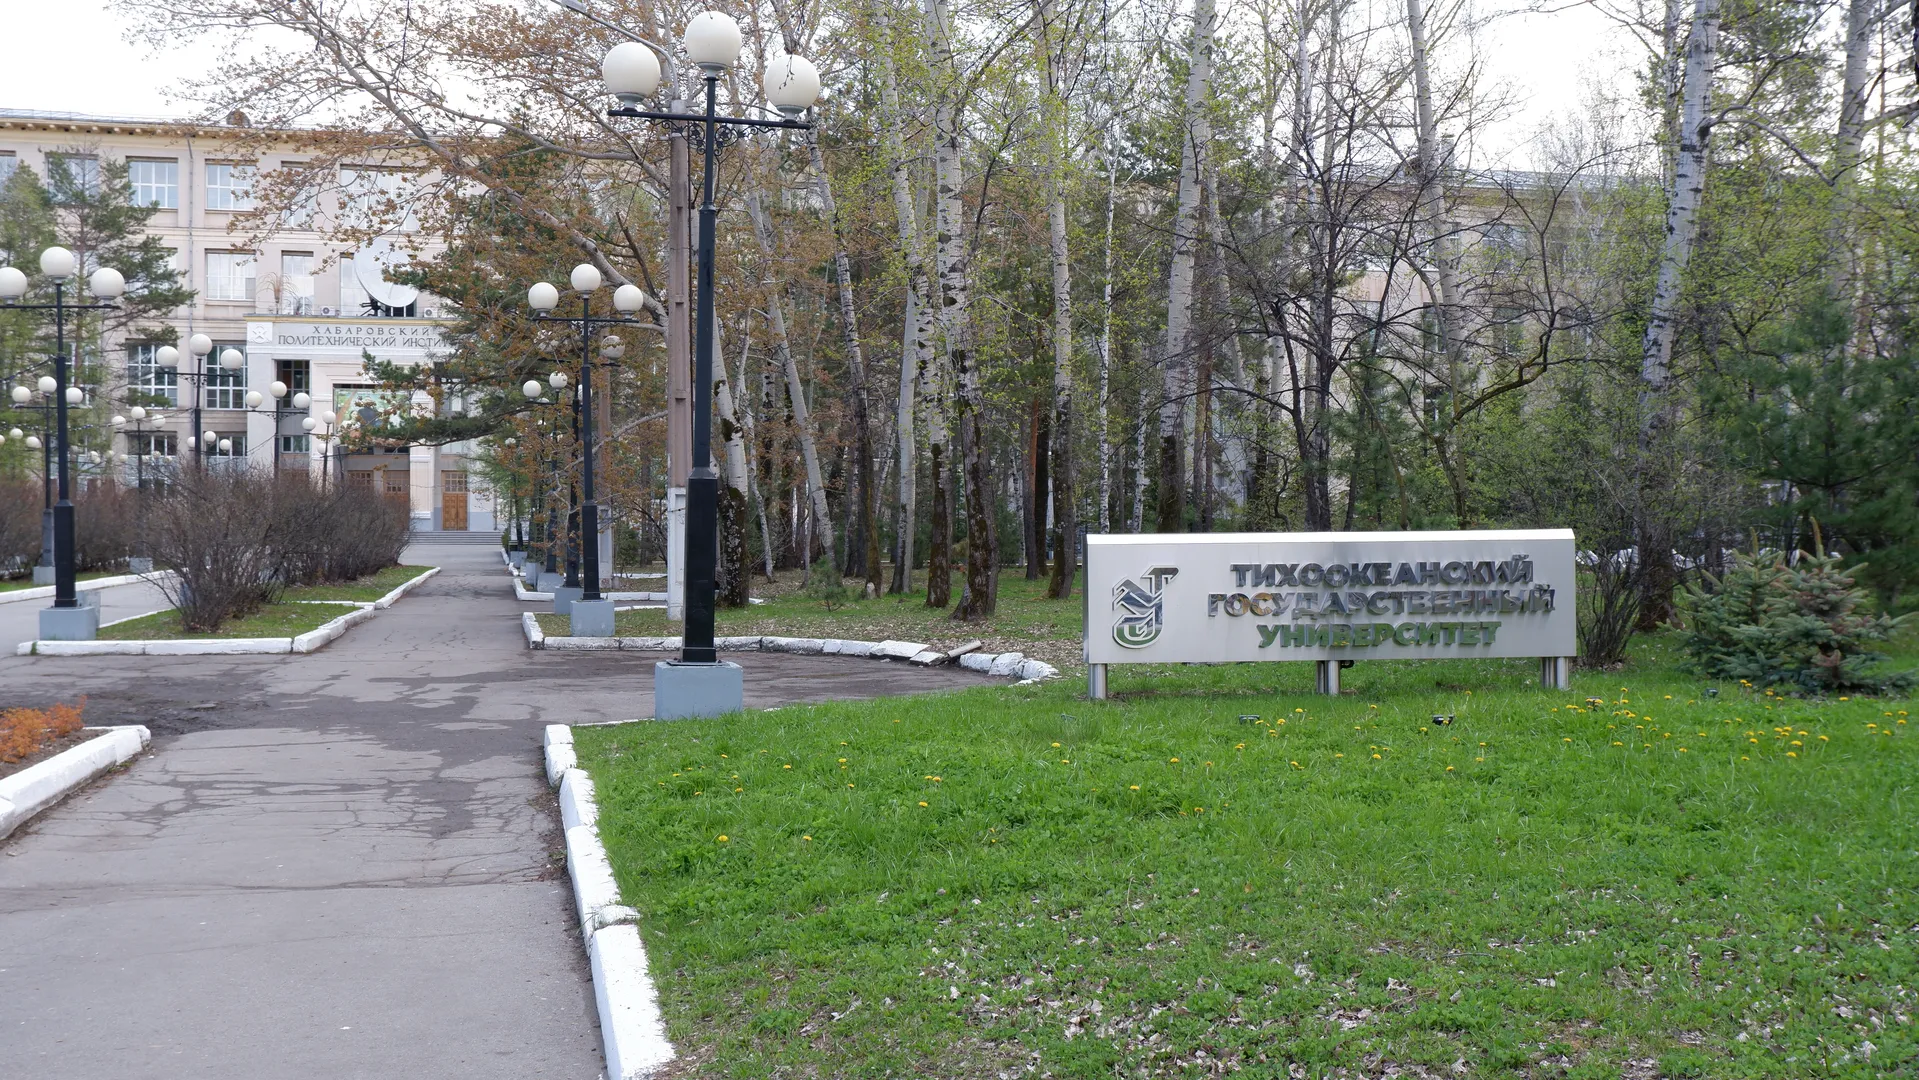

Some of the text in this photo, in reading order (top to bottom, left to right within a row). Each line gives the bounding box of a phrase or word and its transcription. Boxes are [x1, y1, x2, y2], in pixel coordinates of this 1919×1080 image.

[278, 335, 397, 347] ПОЛИТЕХНИЧЕСКИЙ
[313, 326, 430, 336] ХАБАРОВСКИЙ
[1230, 555, 1534, 587] ТИХООКЕАНСКИЙ
[1208, 584, 1556, 620] ГОСУДАРСТВЕННЫЙ
[1256, 621, 1502, 648] УНИВЕРСИТЕТ
